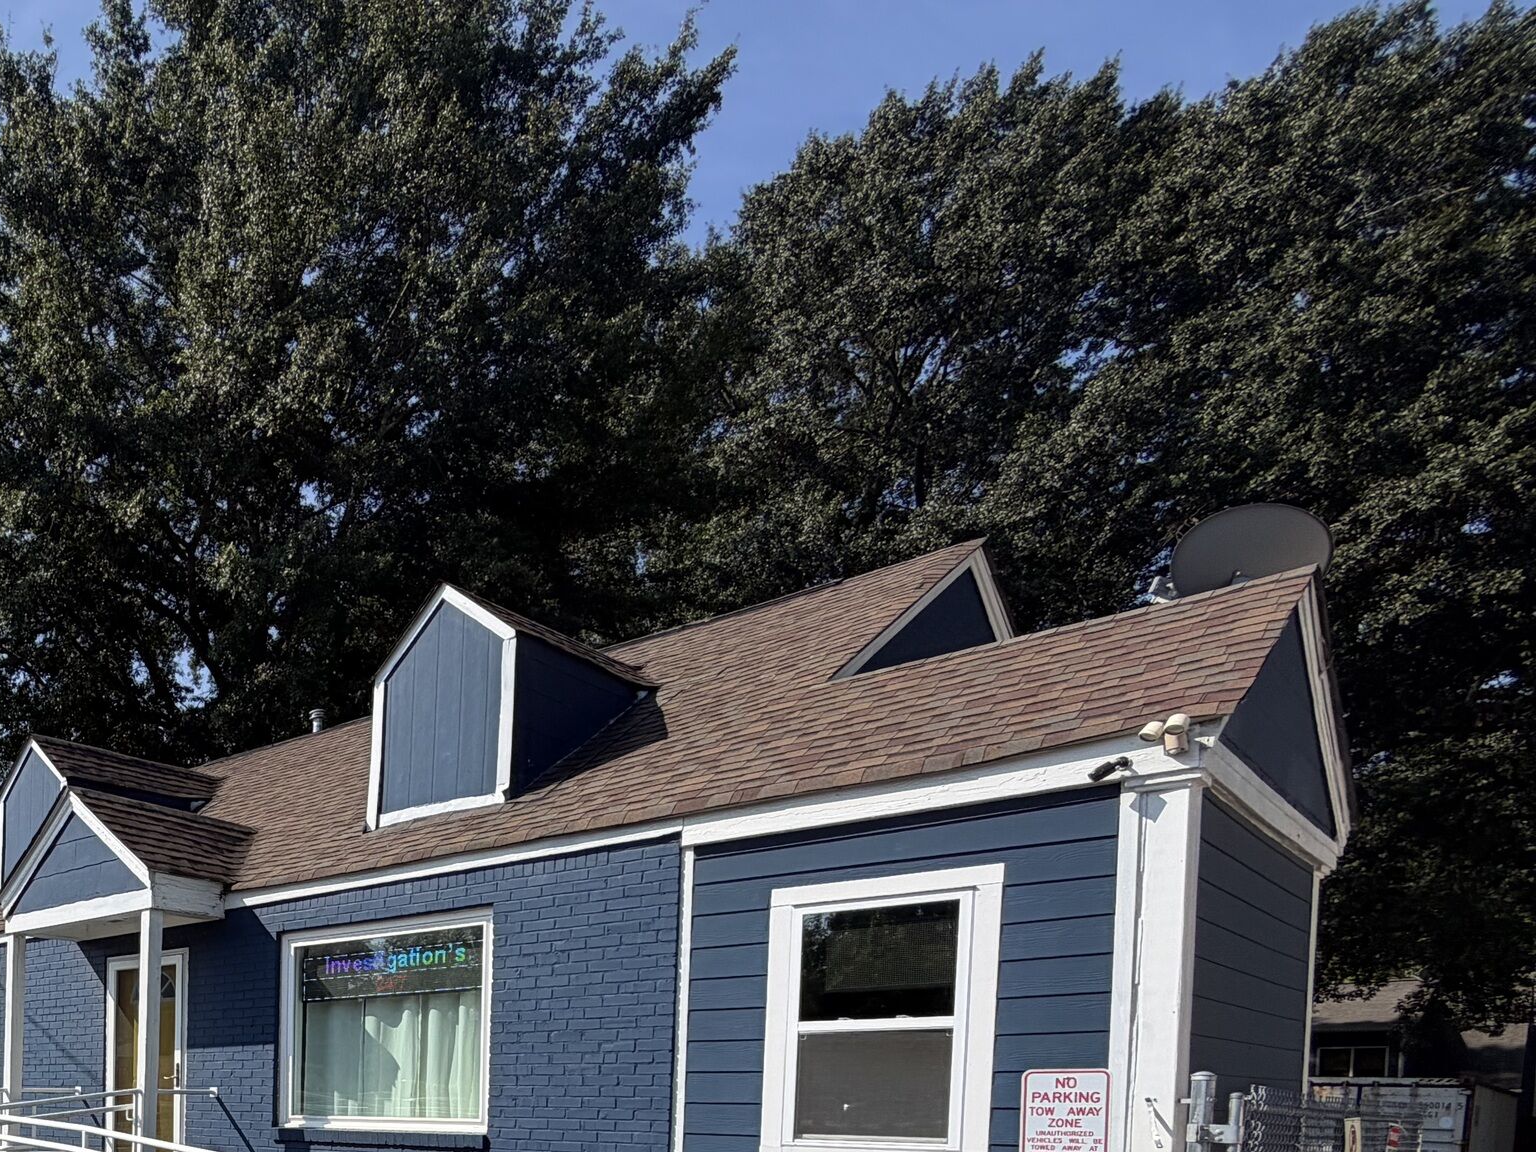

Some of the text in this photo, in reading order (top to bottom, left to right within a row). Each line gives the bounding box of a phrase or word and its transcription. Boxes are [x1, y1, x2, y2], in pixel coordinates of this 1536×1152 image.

[1055, 1077, 1077, 1089] NO
[1031, 1091, 1101, 1103] PARKING
[1029, 1107, 1103, 1116] TOW AWAY
[1048, 1118, 1082, 1128] ZONE
